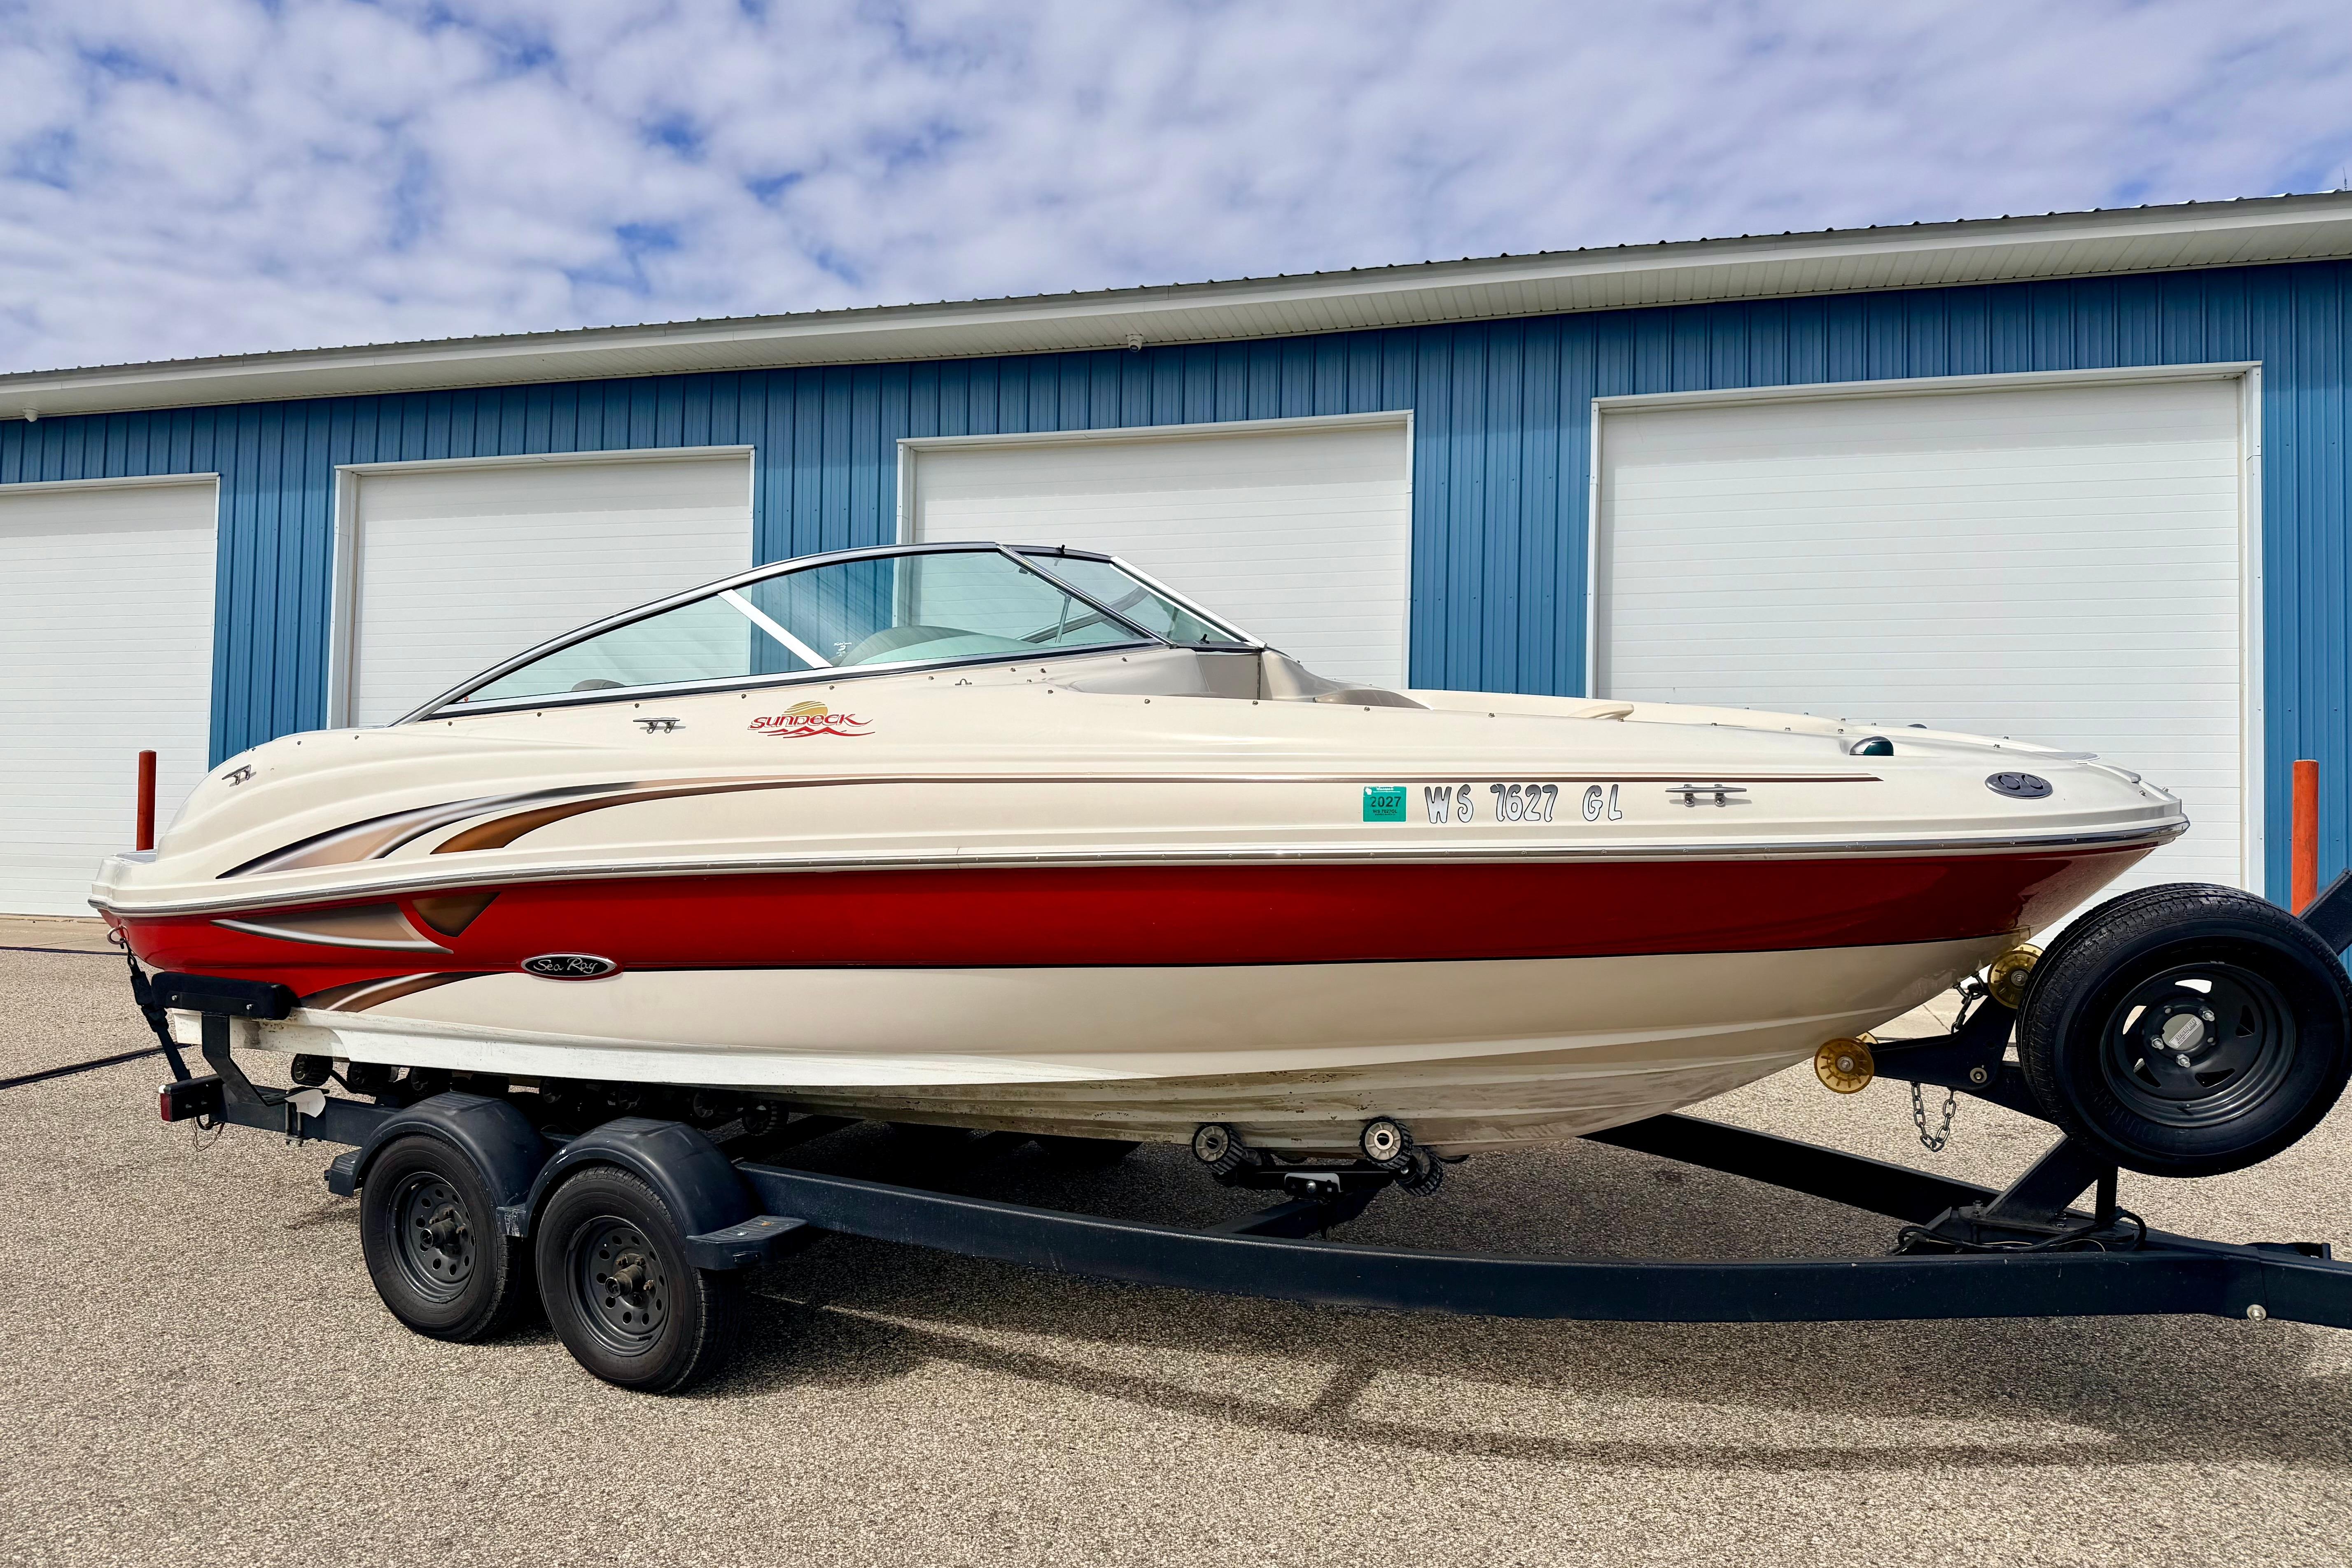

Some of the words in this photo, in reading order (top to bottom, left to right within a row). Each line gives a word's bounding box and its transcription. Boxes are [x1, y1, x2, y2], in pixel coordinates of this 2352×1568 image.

[1370, 796, 1402, 807] 2027
[1425, 784, 1474, 824] WS
[1490, 784, 1558, 822] 7627
[1582, 784, 1622, 821] GL
[534, 959, 564, 971] Sea
[567, 957, 598, 974] Ray
